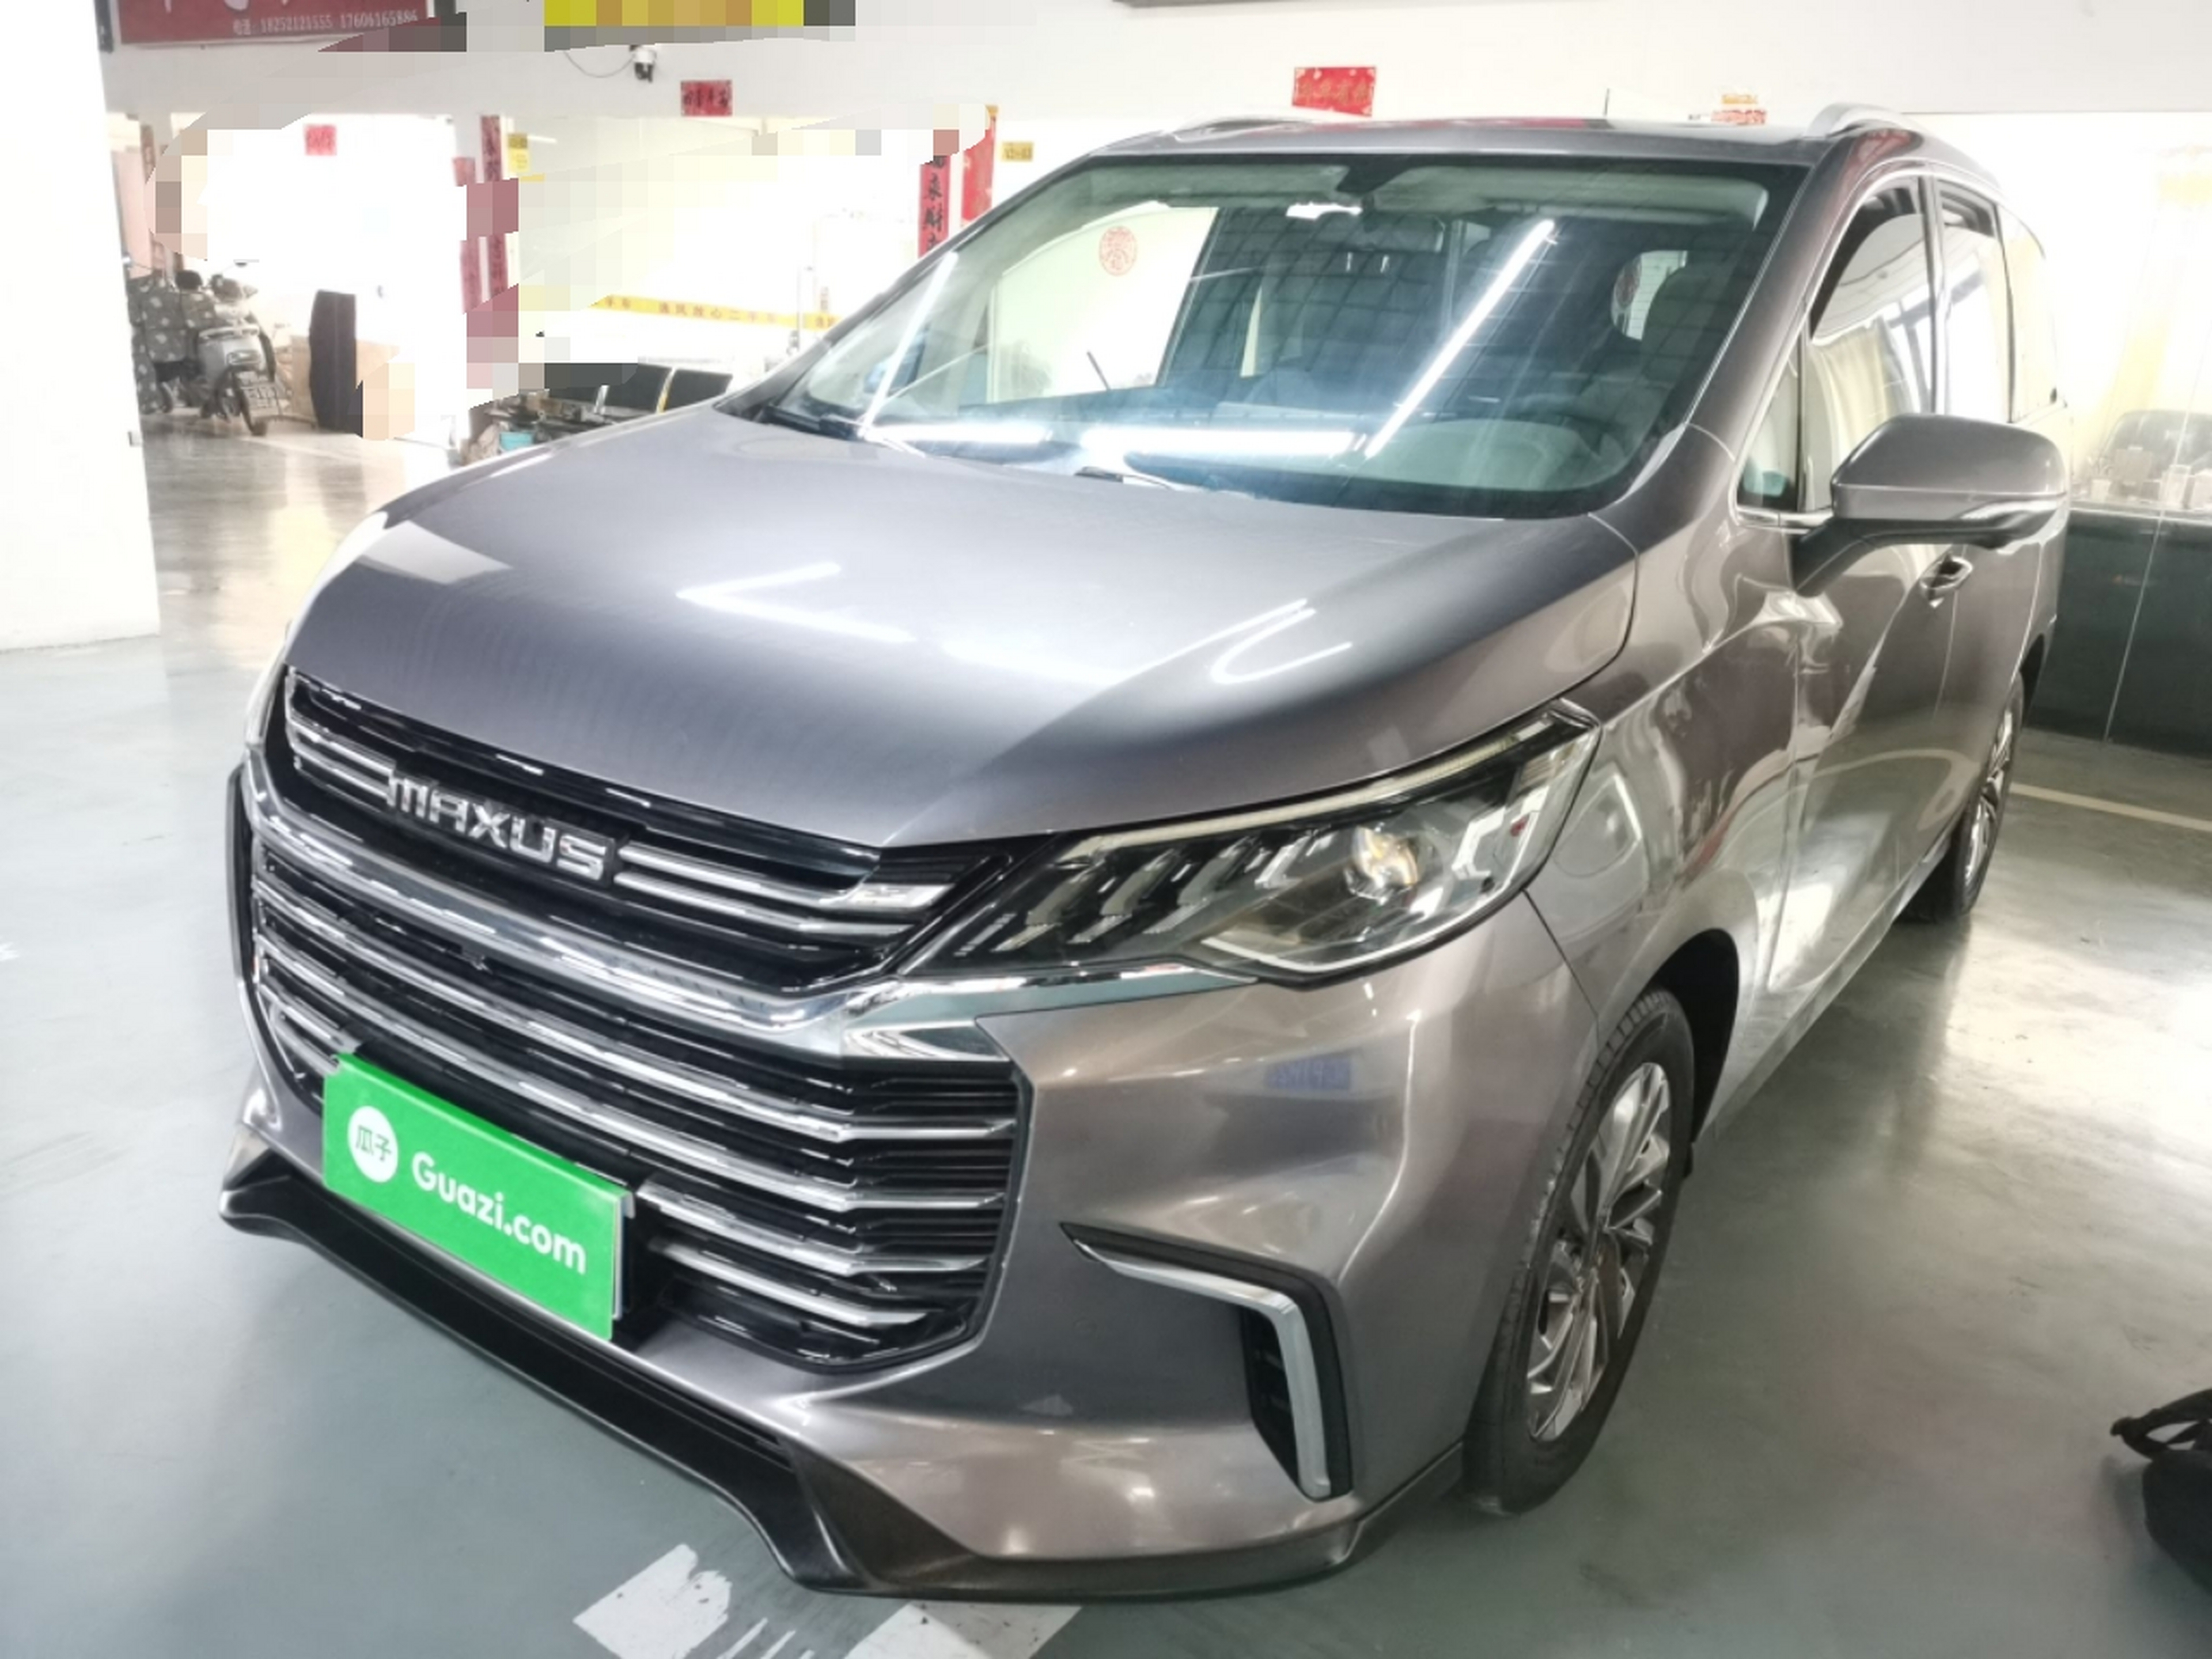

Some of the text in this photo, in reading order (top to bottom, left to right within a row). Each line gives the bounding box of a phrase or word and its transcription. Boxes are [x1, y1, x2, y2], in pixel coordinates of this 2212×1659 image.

[387, 777, 607, 881] MAXUS
[355, 1124, 392, 1162] 瓜子
[411, 1152, 587, 1275] Guazi.com
